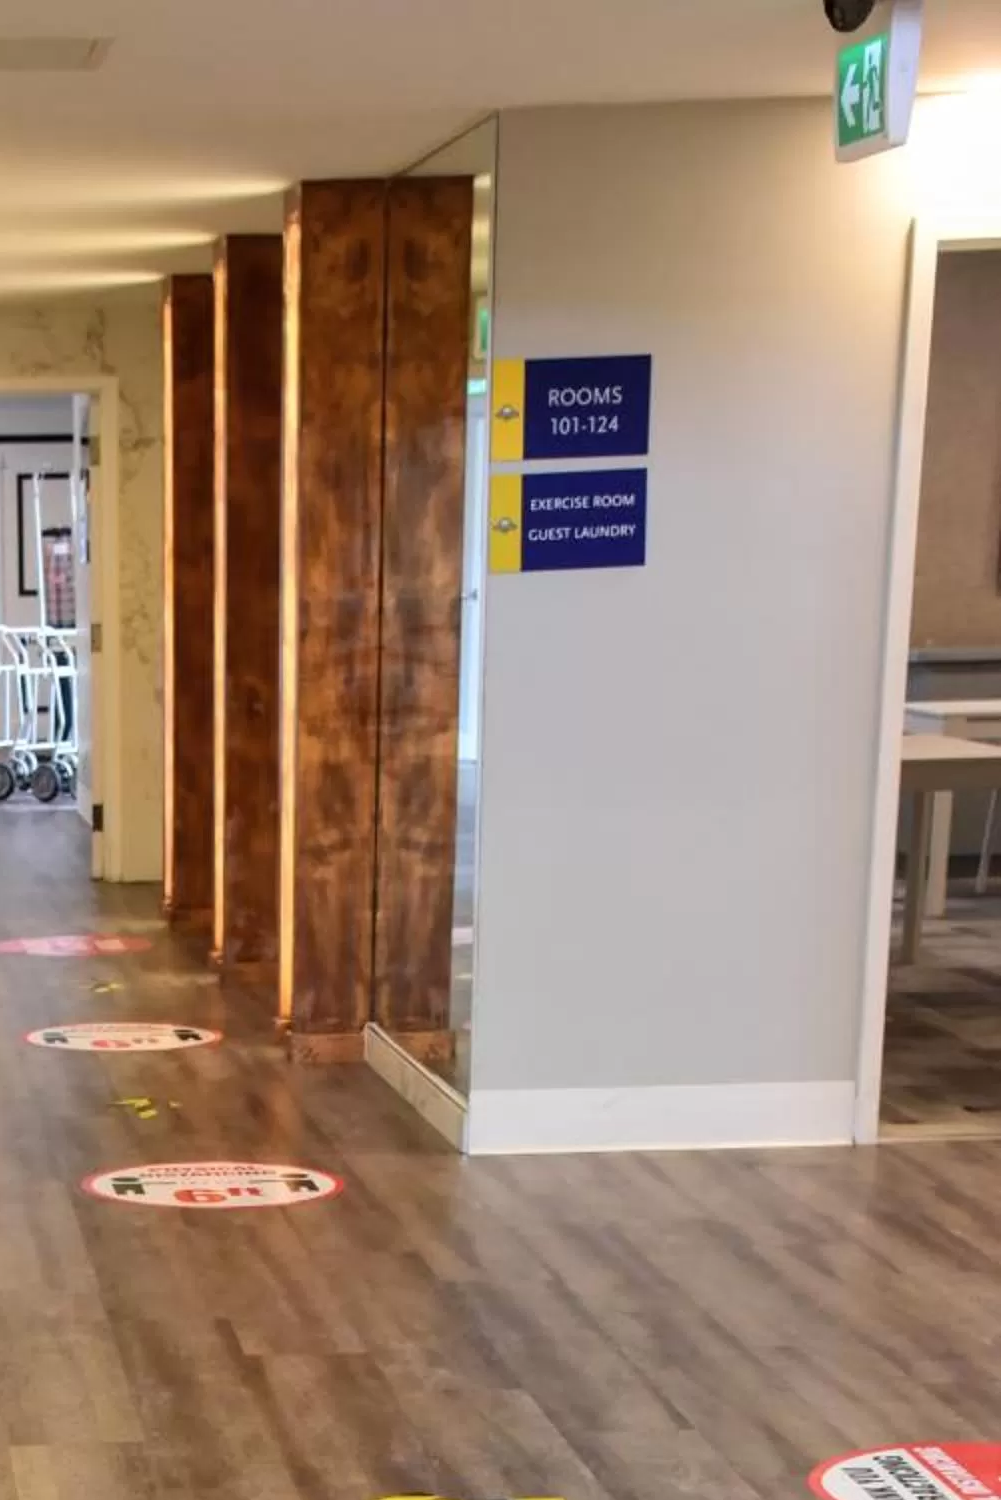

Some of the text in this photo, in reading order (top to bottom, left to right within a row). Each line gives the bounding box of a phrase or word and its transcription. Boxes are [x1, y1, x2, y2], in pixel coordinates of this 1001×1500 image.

[548, 386, 623, 407] ROOMS
[551, 415, 619, 435] 101-124
[530, 493, 636, 511] EXERCISE ROOM
[528, 523, 636, 541] GUEST LAUNDRY
